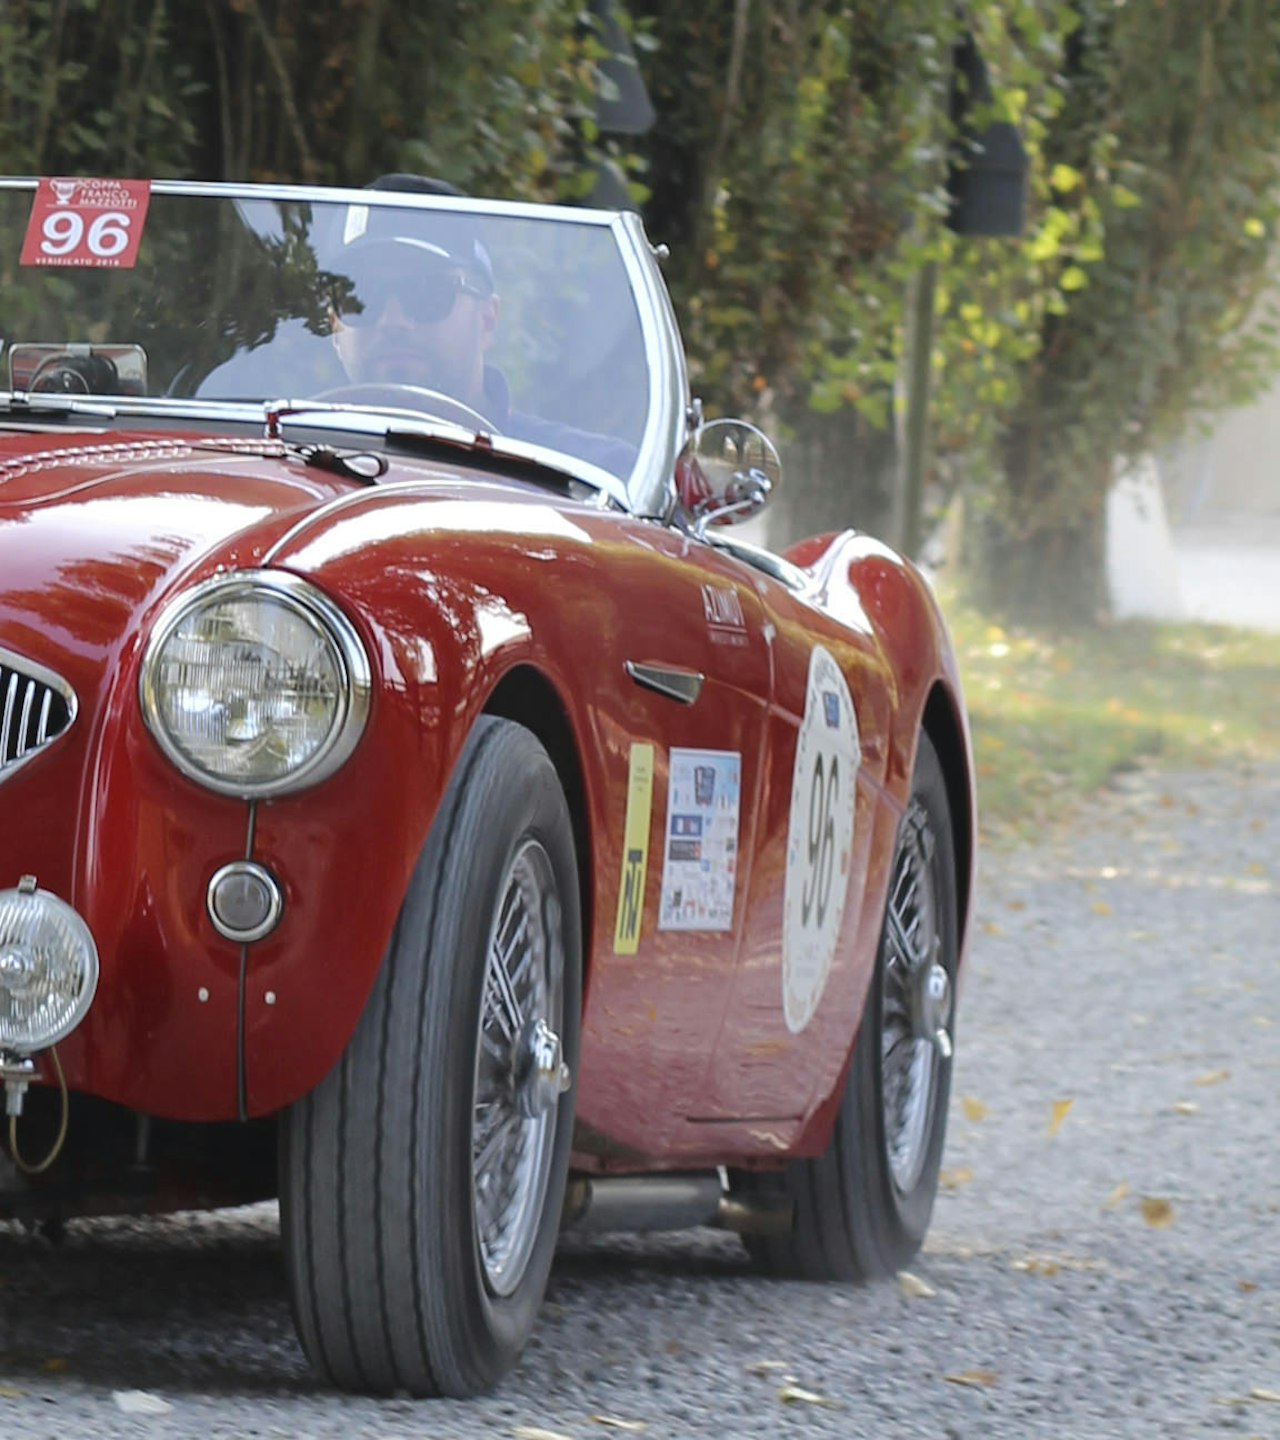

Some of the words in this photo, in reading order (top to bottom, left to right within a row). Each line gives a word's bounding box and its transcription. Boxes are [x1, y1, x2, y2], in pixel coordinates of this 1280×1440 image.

[82, 181, 121, 190] COPPA
[80, 189, 129, 199] FRANCO
[79, 198, 137, 208] MAZZOTTI
[40, 210, 131, 257] 96
[35, 257, 92, 266] VERIFICATO
[801, 751, 839, 928] 96
